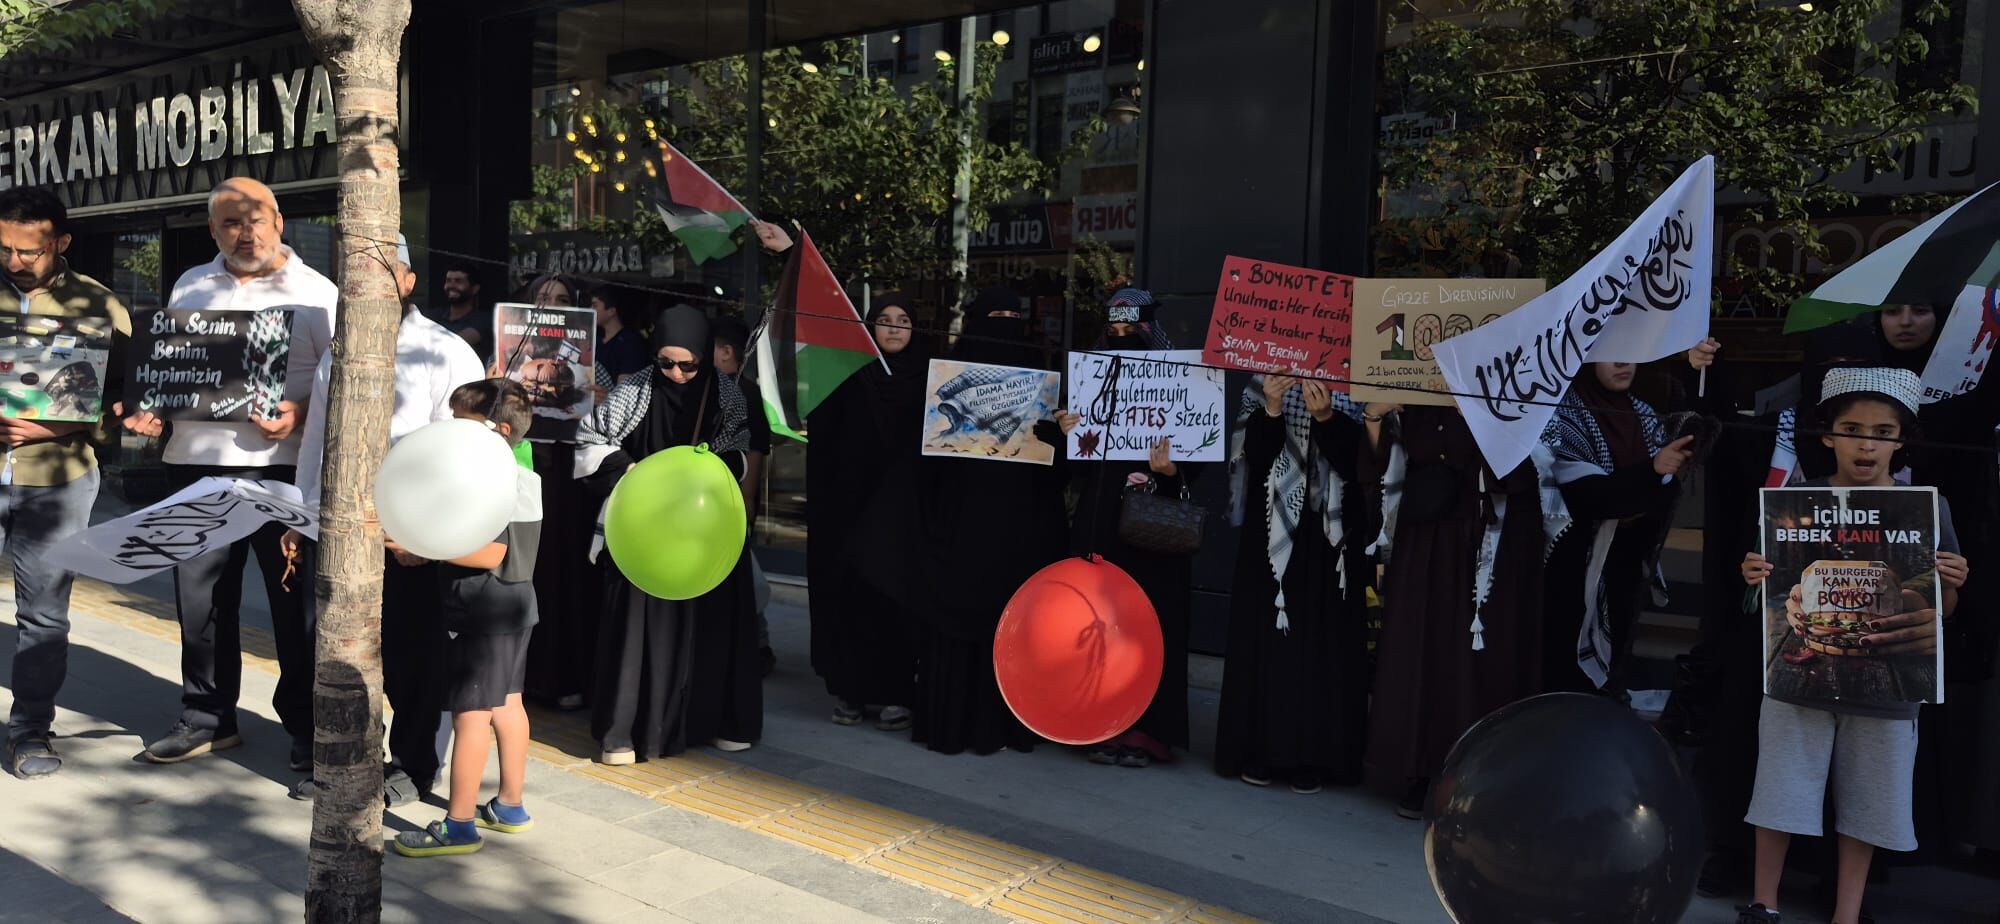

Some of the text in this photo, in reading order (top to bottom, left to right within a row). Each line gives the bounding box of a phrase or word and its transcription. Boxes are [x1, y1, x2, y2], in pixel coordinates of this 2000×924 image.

[136, 62, 337, 171] MOBİLYA
[1248, 263, 1319, 291] BOYKOT
[1224, 288, 1284, 311] Unutma:
[1286, 297, 1311, 314] Her
[151, 311, 237, 337] Bu Senin,
[1230, 312, 1250, 328] Bir
[1254, 320, 1266, 332] iz
[540, 327, 565, 337] KANI
[567, 328, 587, 340] VAR
[151, 340, 209, 361] Benim,
[136, 363, 224, 391] Hepimizin
[1175, 402, 1220, 427] sizede
[1813, 505, 1881, 528] İÇİNDE
[1775, 528, 1921, 544] BEBEK KANI VAR
[1814, 567, 1889, 578] BU BURGERDE
[1822, 577, 1880, 588] KAN VAR
[1817, 590, 1885, 609] BOYKOT
